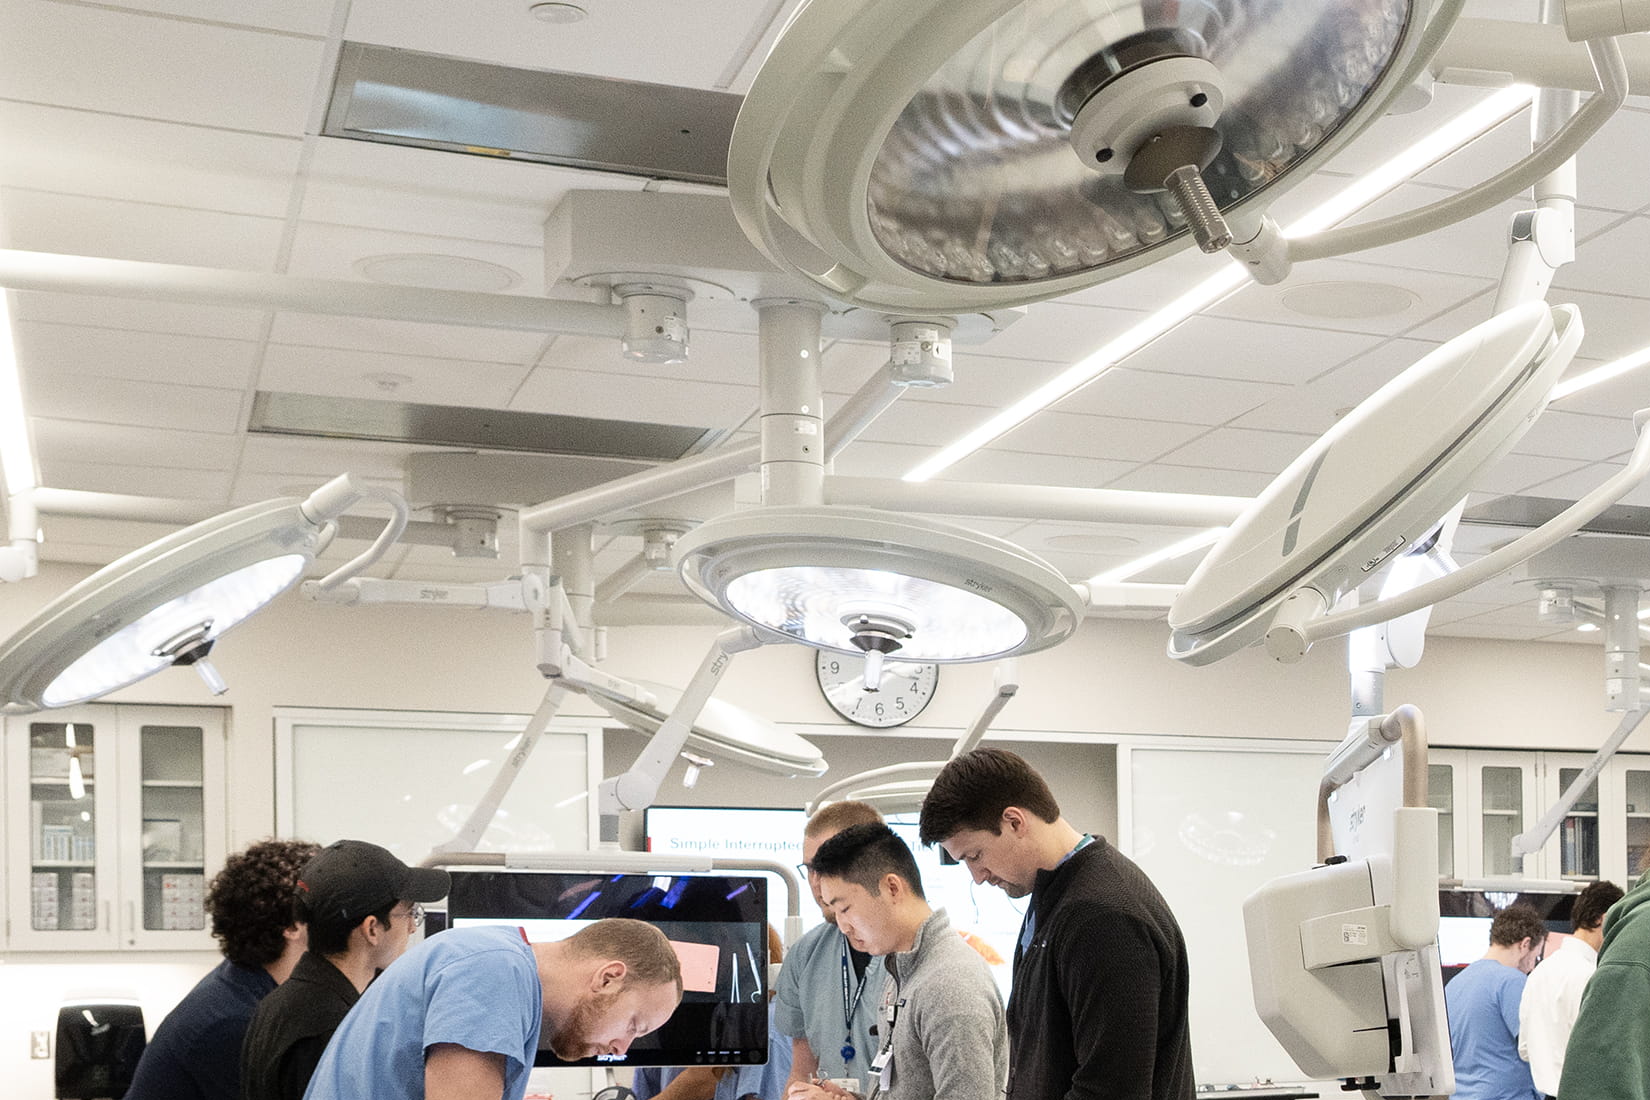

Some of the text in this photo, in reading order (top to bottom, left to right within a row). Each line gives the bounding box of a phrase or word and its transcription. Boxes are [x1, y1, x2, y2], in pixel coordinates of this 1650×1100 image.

[710, 650, 728, 676] stry
[830, 661, 840, 674] 9
[910, 682, 919, 694] 4
[875, 703, 884, 716] 6
[895, 697, 905, 710] 5
[670, 838, 720, 851] Simple
